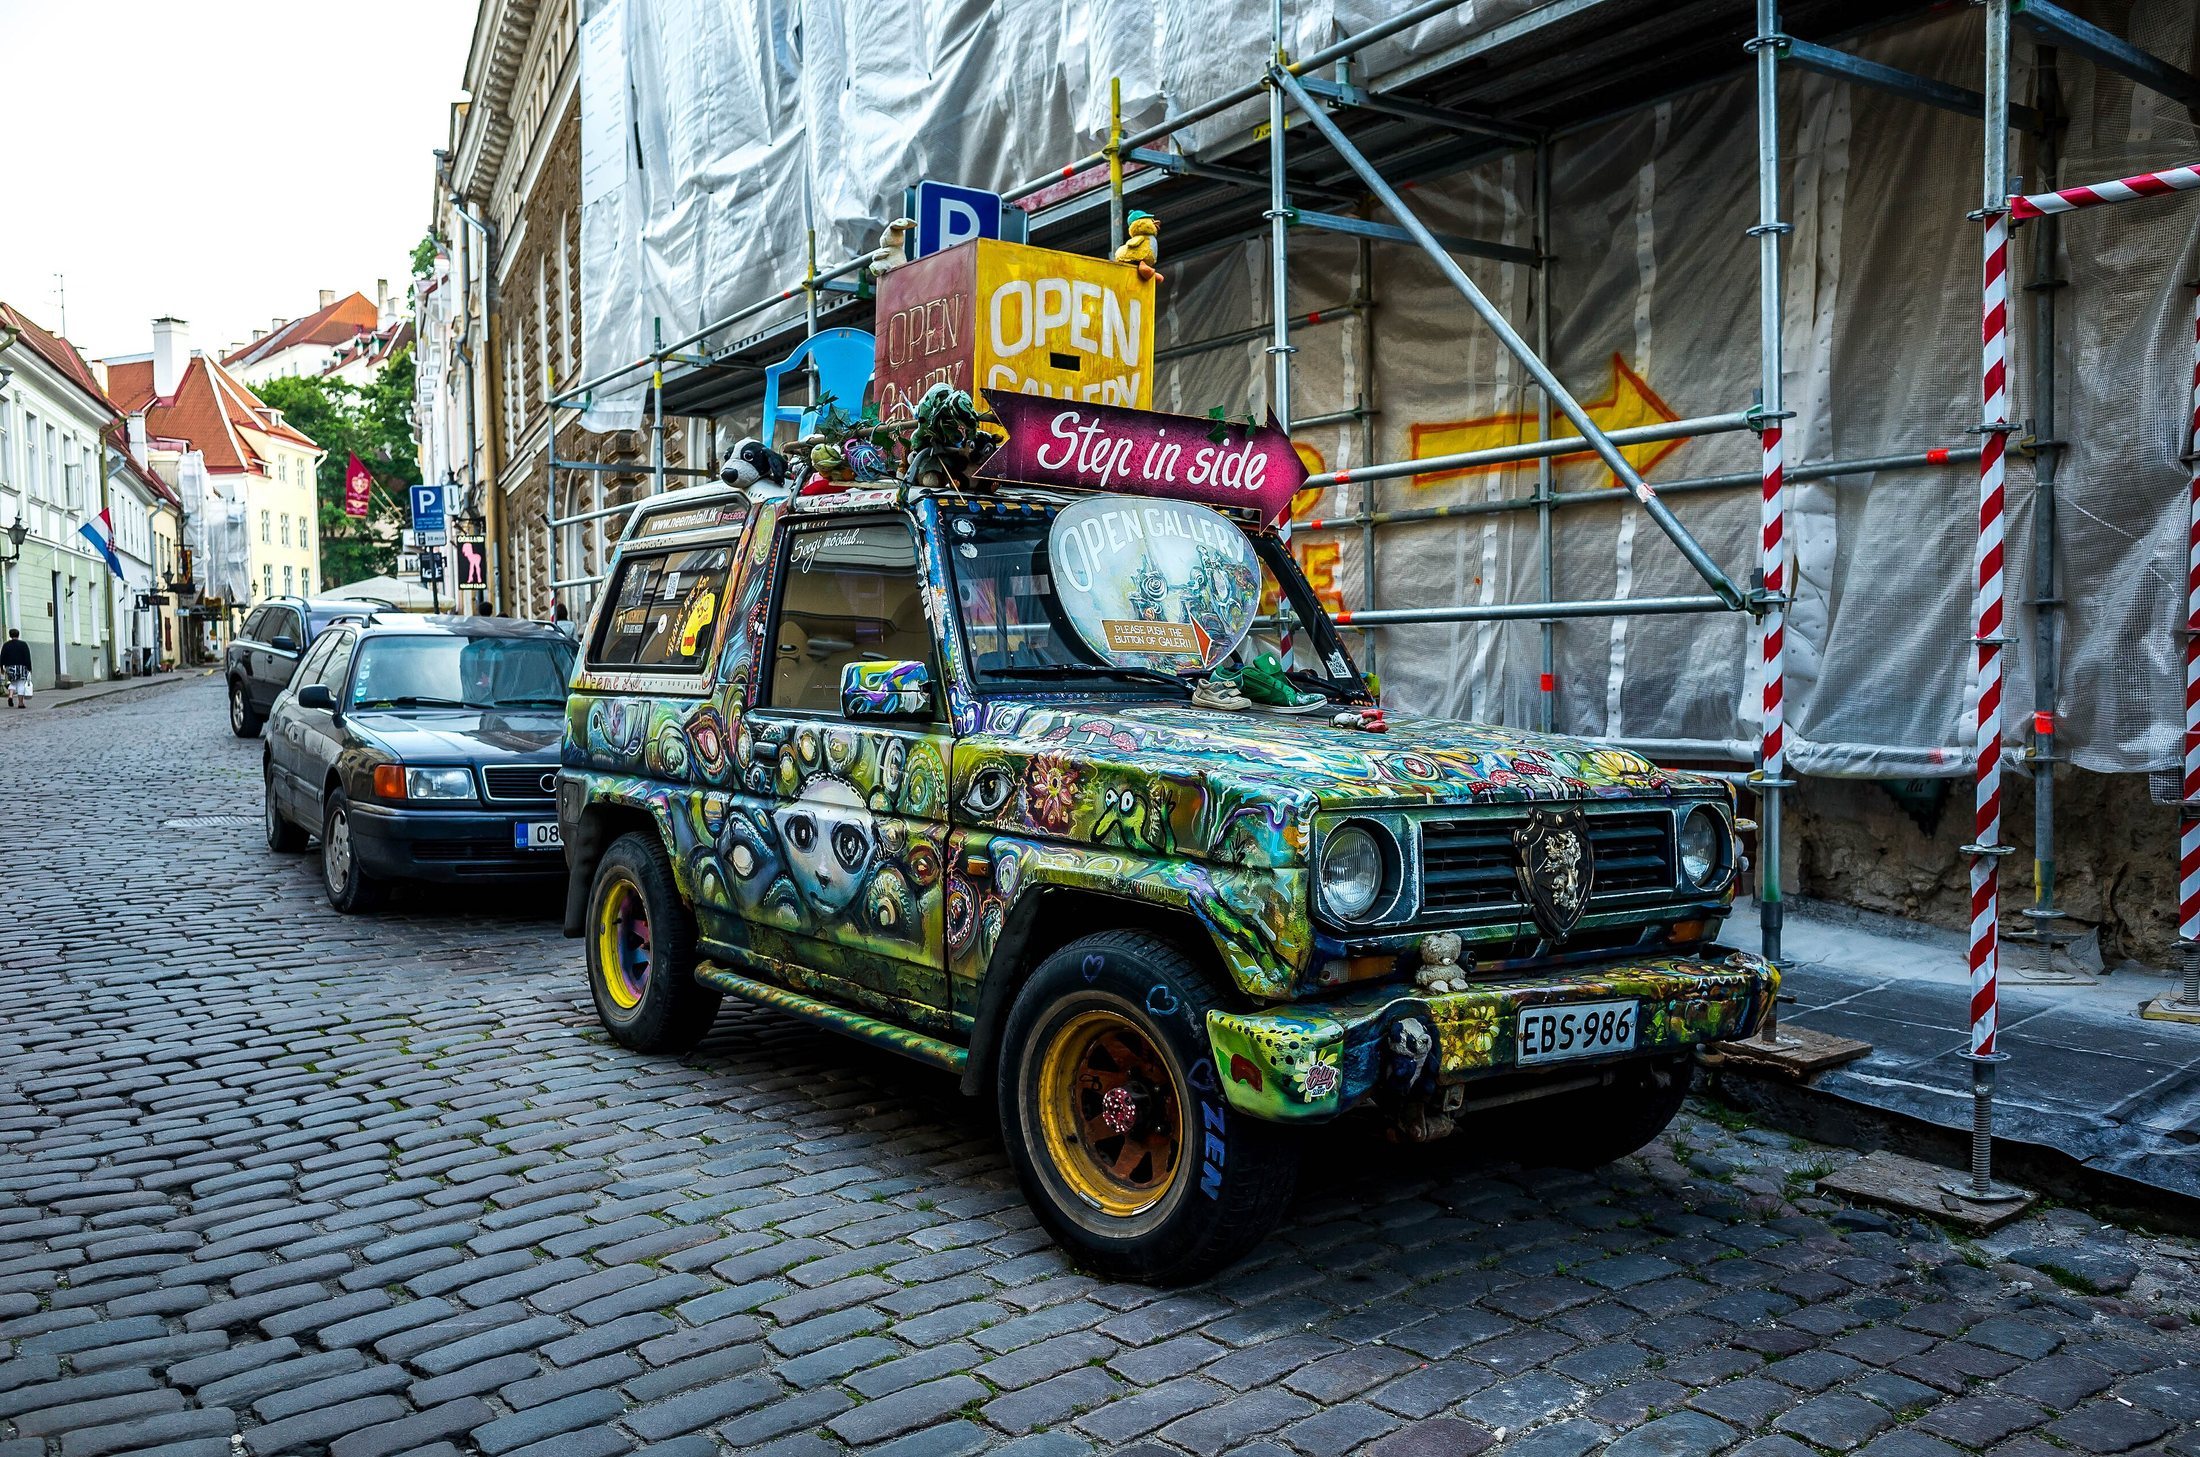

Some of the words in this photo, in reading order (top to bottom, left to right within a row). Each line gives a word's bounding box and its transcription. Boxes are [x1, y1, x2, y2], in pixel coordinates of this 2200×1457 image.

[939, 197, 981, 252] P
[888, 293, 961, 368] OPEN
[990, 278, 1142, 367] OPEN
[1036, 411, 1135, 487] Step
[1142, 428, 1182, 483] in
[1186, 438, 1268, 491] side
[419, 490, 435, 513] P
[790, 534, 823, 574] Seegi
[1057, 508, 1145, 593] OPEN
[1143, 507, 1245, 563] GALLERY
[1114, 625, 1145, 634] PLEASE
[1146, 626, 1165, 635] PUSH
[1168, 628, 1182, 636] THE
[1114, 635, 1144, 644] BUTTON
[1146, 636, 1155, 644] OF
[1200, 1100, 1226, 1201] ZEN
